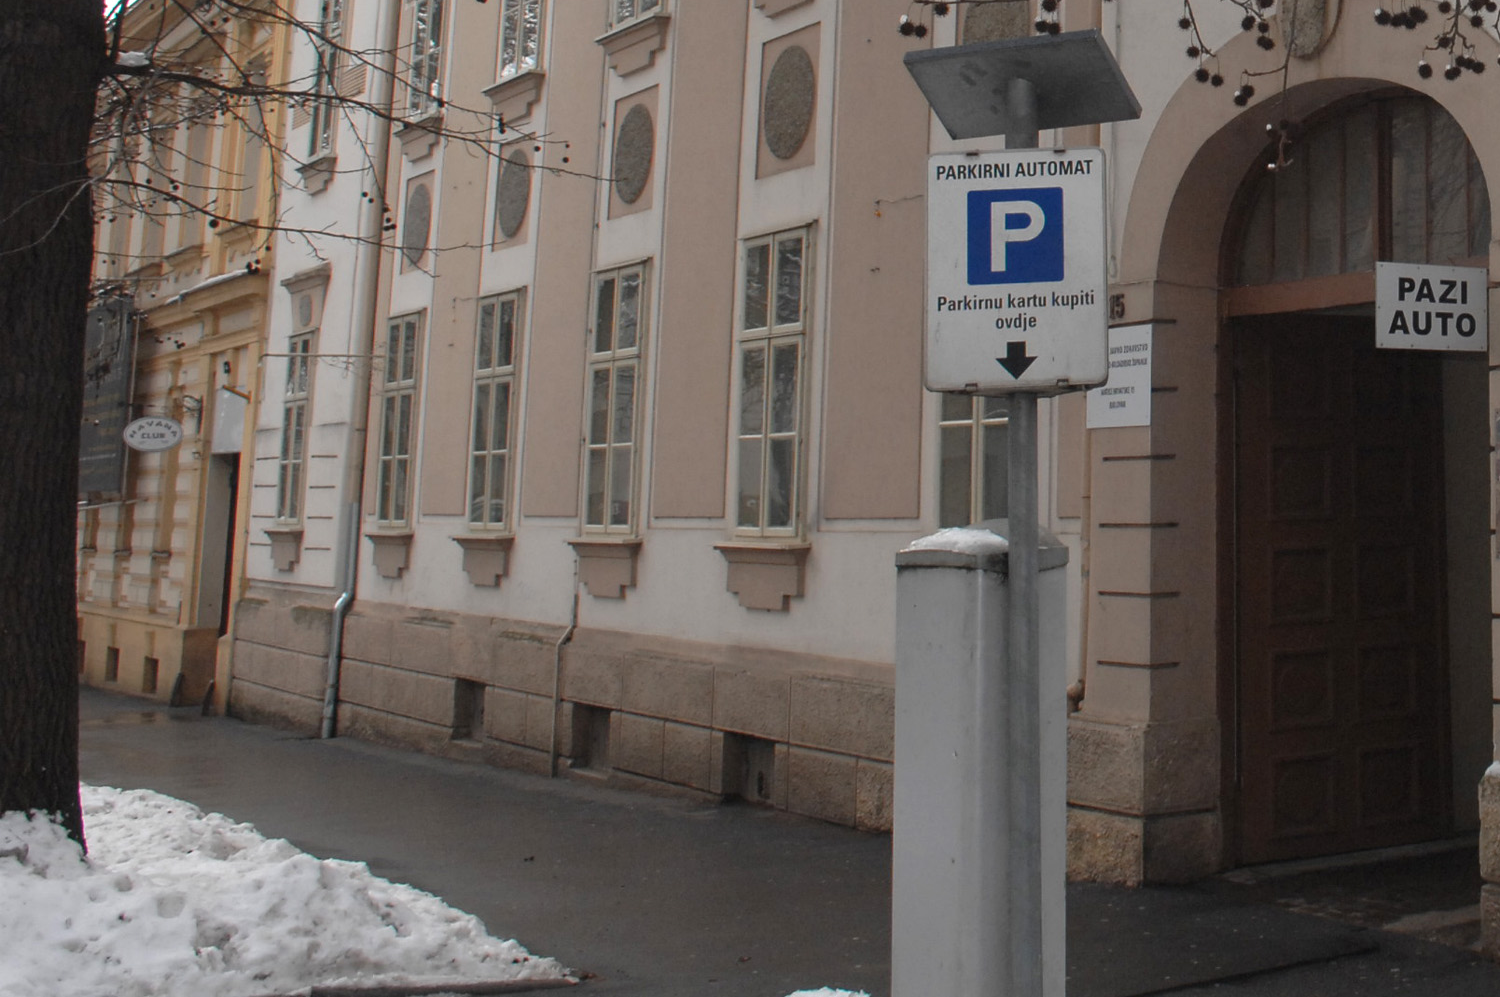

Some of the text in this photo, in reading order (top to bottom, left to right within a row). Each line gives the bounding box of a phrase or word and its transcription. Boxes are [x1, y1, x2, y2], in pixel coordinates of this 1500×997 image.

[936, 159, 1093, 181] PARKIRNI AUTOMAT
[990, 200, 1046, 273] P
[937, 289, 1095, 312] Parkirnu kartu kupiti
[1398, 277, 1468, 305] PAZI
[1109, 293, 1125, 320] 15
[995, 312, 1037, 332] ovdje
[1388, 310, 1477, 338] AUTO
[128, 420, 178, 438] HAVANA
